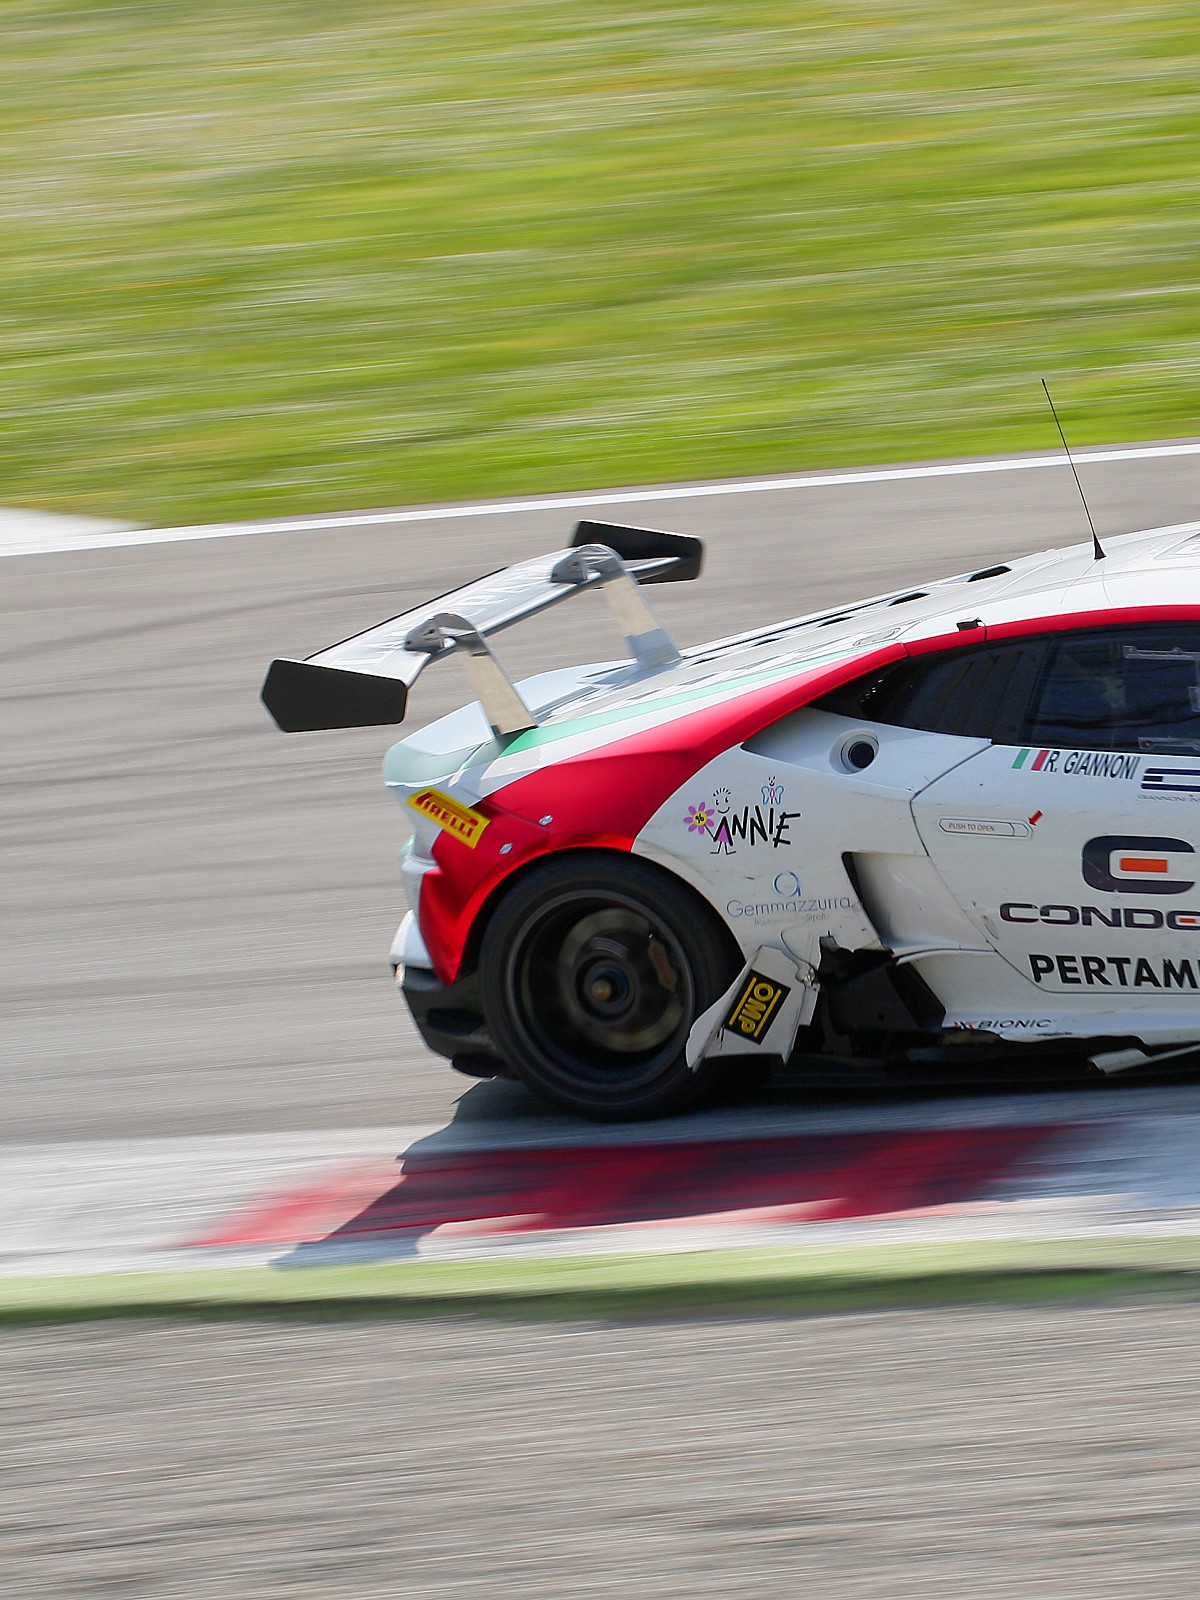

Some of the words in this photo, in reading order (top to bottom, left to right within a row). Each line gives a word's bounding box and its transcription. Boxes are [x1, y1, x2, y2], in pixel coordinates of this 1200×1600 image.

[1044, 751, 1060, 773] R.
[1064, 751, 1141, 780] GIANNONI
[415, 792, 479, 838] PIRELLI
[713, 805, 801, 849] ANNIE
[948, 822, 966, 830] PUSH
[967, 823, 976, 831] TO
[977, 824, 995, 832] OPEN
[738, 982, 774, 1034] OMP
